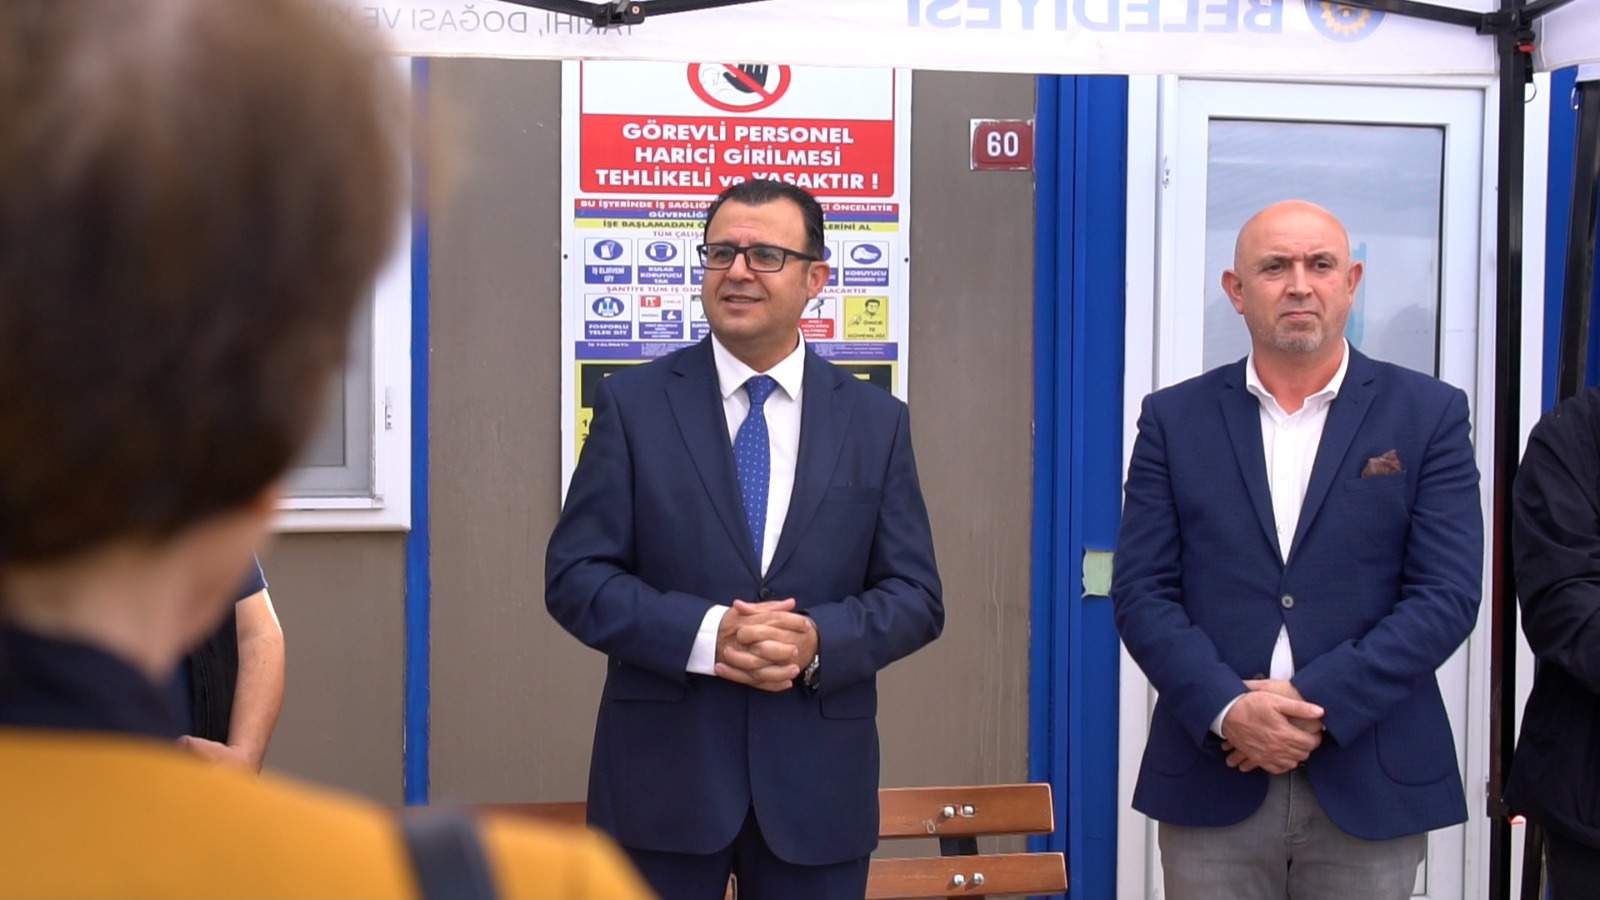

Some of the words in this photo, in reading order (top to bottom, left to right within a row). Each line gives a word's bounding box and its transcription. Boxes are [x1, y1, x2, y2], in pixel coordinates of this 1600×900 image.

[622, 119, 727, 141] GÖREVLİ
[734, 125, 854, 144] PERSONEL
[635, 143, 716, 164] HARİCİ
[723, 144, 841, 166] GİRİLMESİ
[986, 131, 1019, 157] 60
[595, 166, 711, 187] TEHLİKELİ
[718, 175, 746, 187] ve
[871, 173, 879, 190] !
[580, 200, 596, 209] BU
[599, 201, 653, 210] İŞYERİNDE
[656, 201, 666, 210] İŞ
[832, 203, 893, 212] ÖNCELİKTİR
[603, 219, 618, 229] İŞE
[621, 220, 694, 229] BAŞLAMADAN
[858, 223, 872, 231] AL
[653, 230, 673, 238] TÜM
